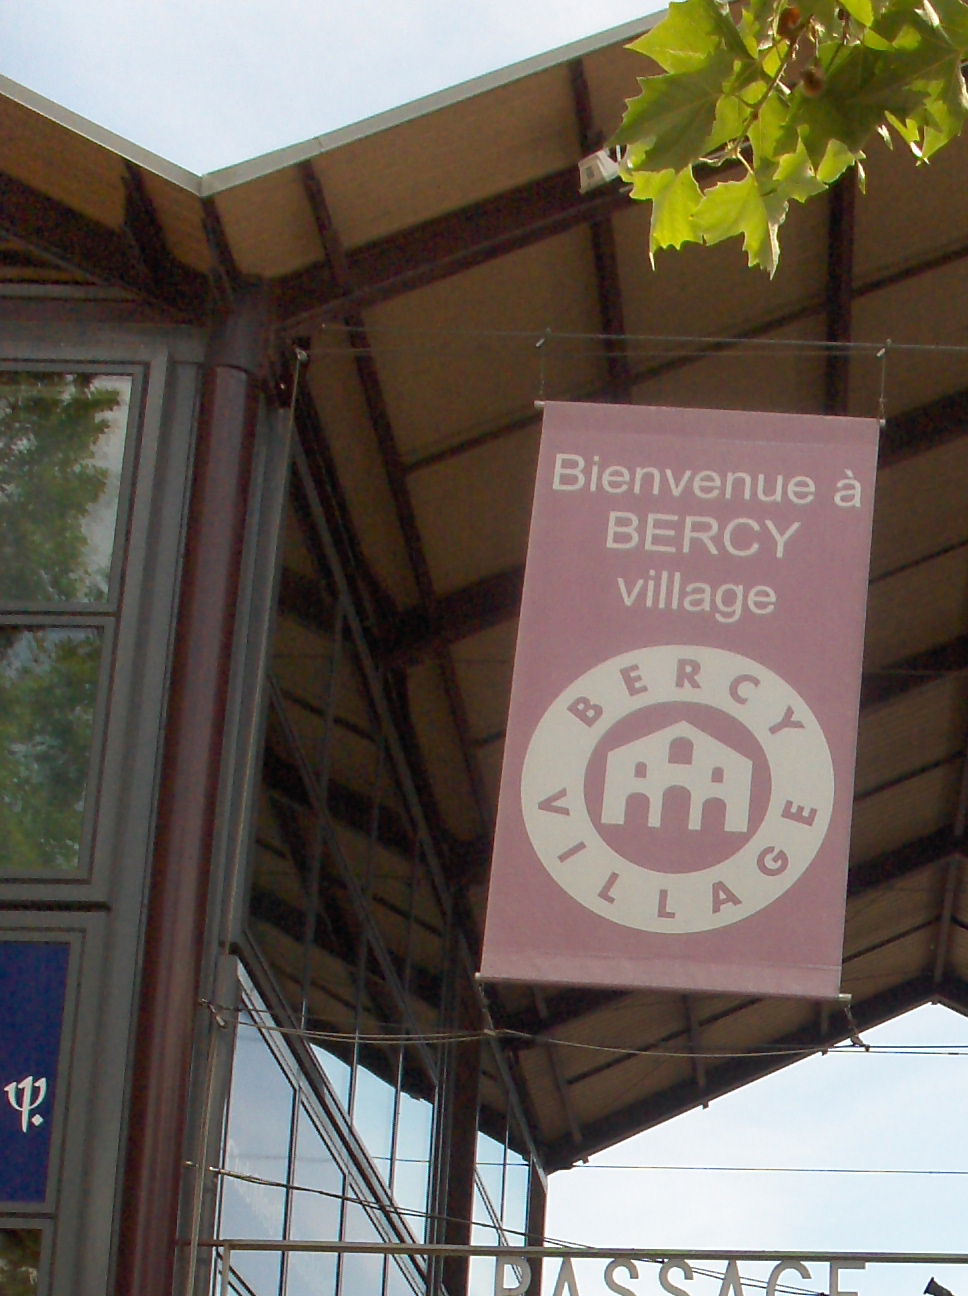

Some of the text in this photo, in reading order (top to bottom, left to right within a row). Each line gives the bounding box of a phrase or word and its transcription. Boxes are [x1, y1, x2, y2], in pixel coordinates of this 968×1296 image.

[552, 453, 863, 508] Bienvenue à
[605, 510, 802, 559] BERCY
[616, 568, 778, 624] village
[566, 657, 805, 736] BERCY
[537, 786, 819, 919] VILLAGE
